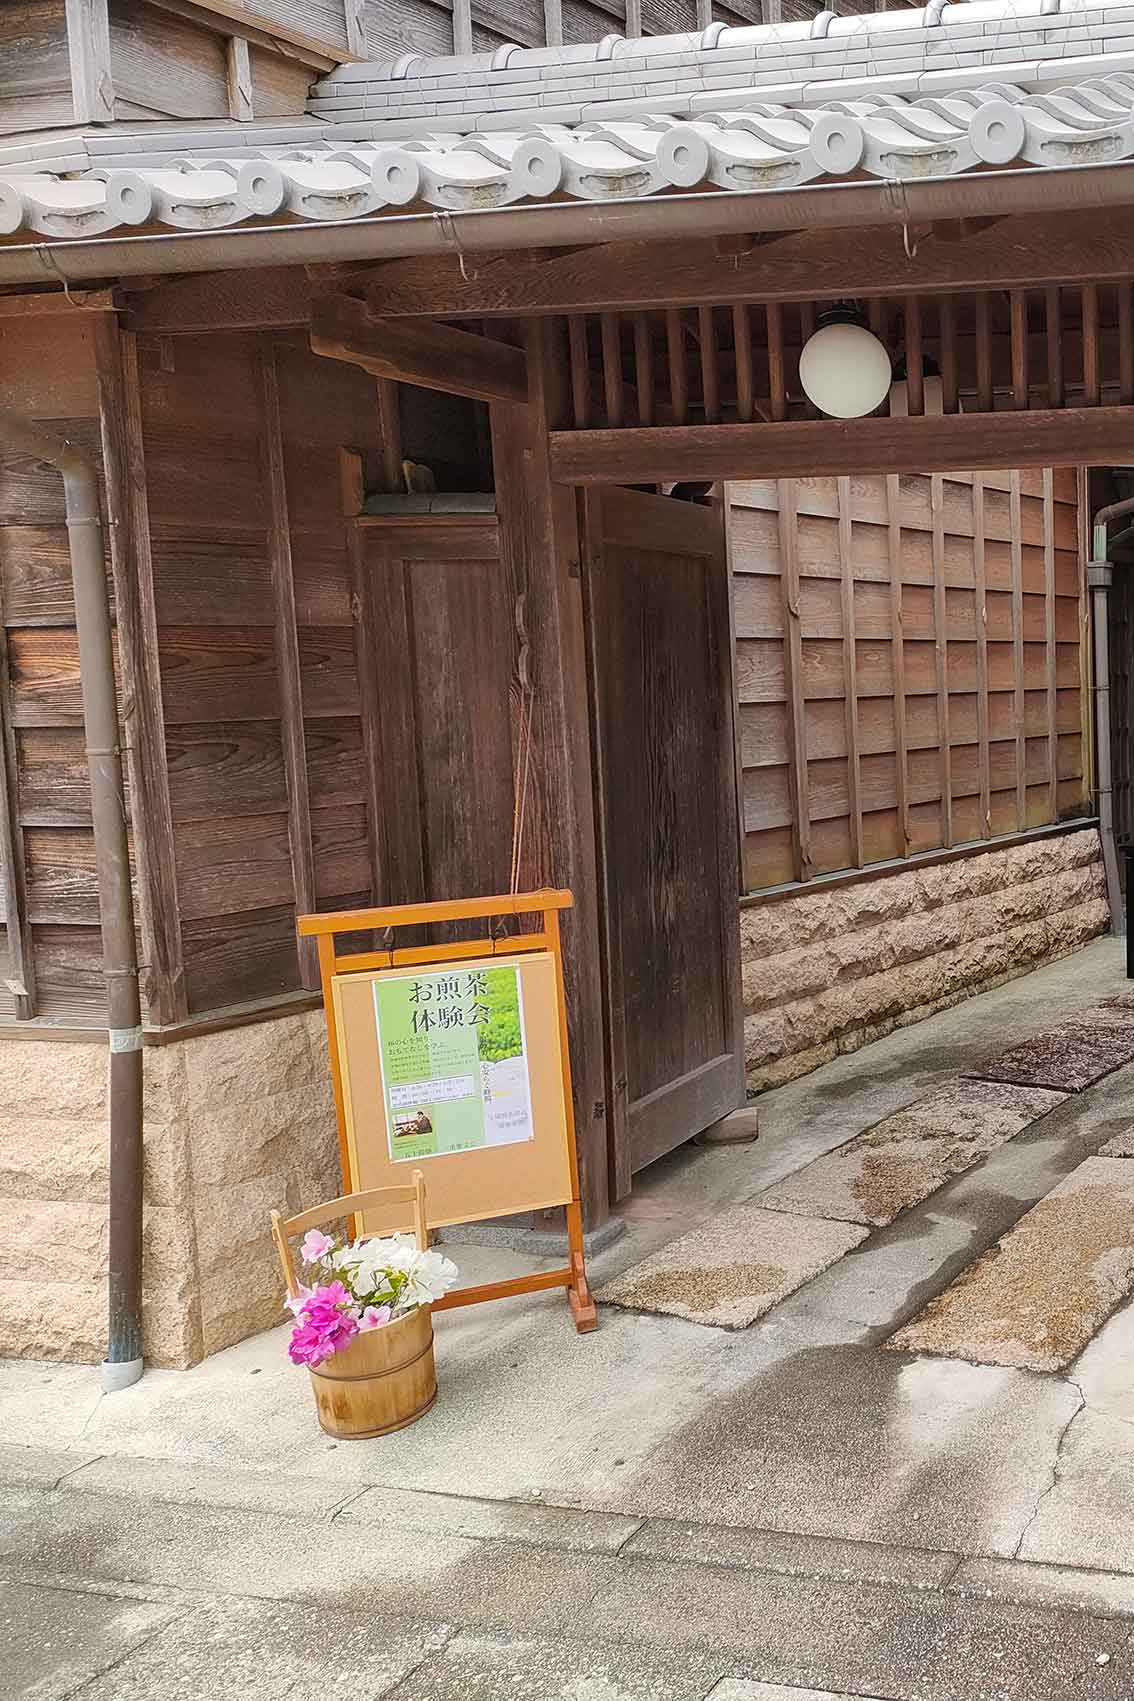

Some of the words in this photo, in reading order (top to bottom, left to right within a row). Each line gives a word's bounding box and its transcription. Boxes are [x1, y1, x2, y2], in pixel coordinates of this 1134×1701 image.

[408, 973, 488, 1004] お煎茶
[410, 1002, 492, 1034] 体験会
